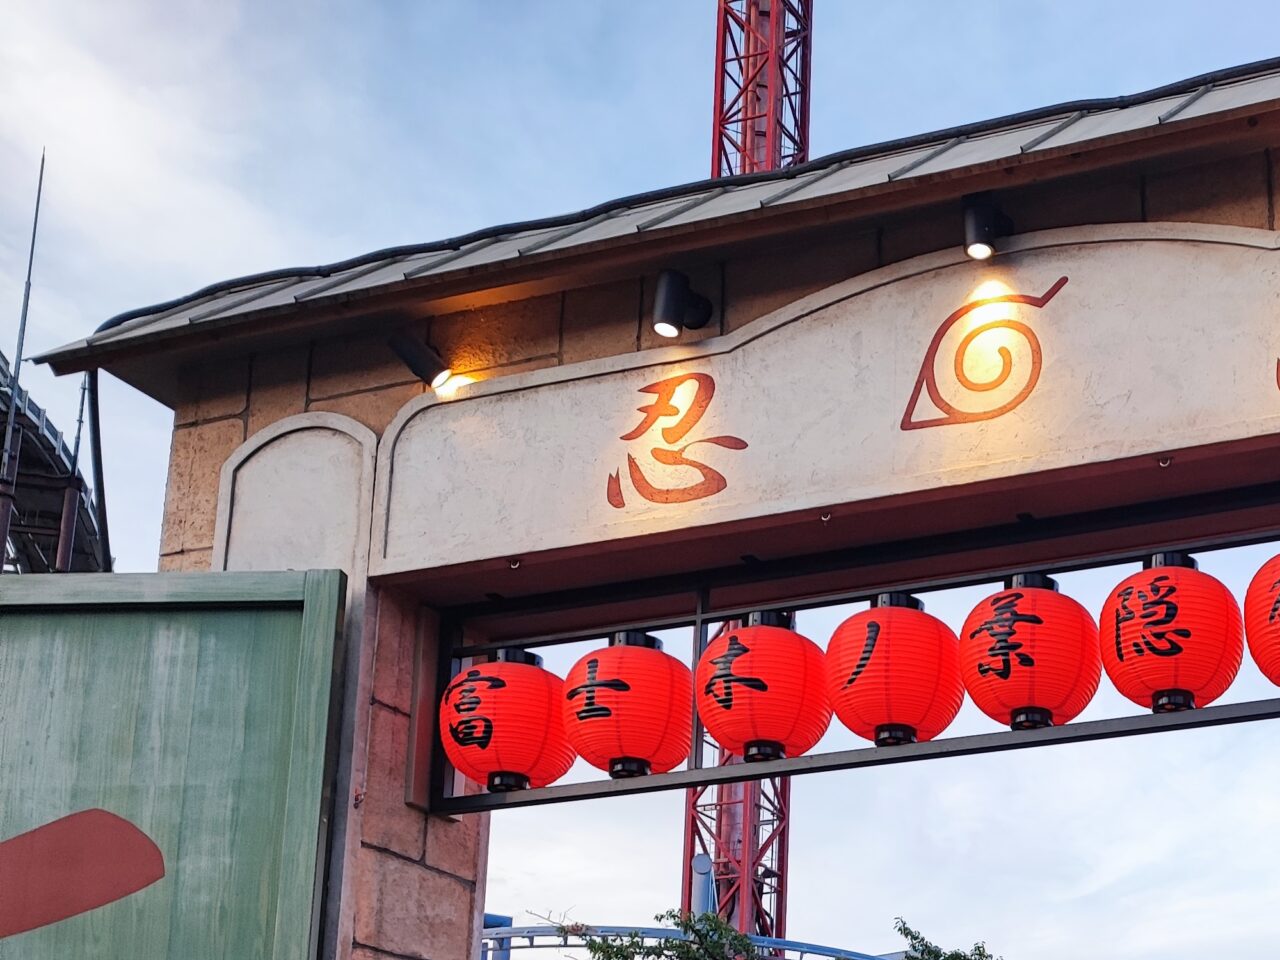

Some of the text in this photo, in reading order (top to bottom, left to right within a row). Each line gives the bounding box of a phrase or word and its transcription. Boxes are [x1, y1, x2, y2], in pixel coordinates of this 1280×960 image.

[607, 373, 748, 508] 忍
[443, 669, 506, 752] 富
[567, 658, 631, 721] 士
[971, 591, 1043, 680] 葉
[1116, 576, 1192, 661] 隠
